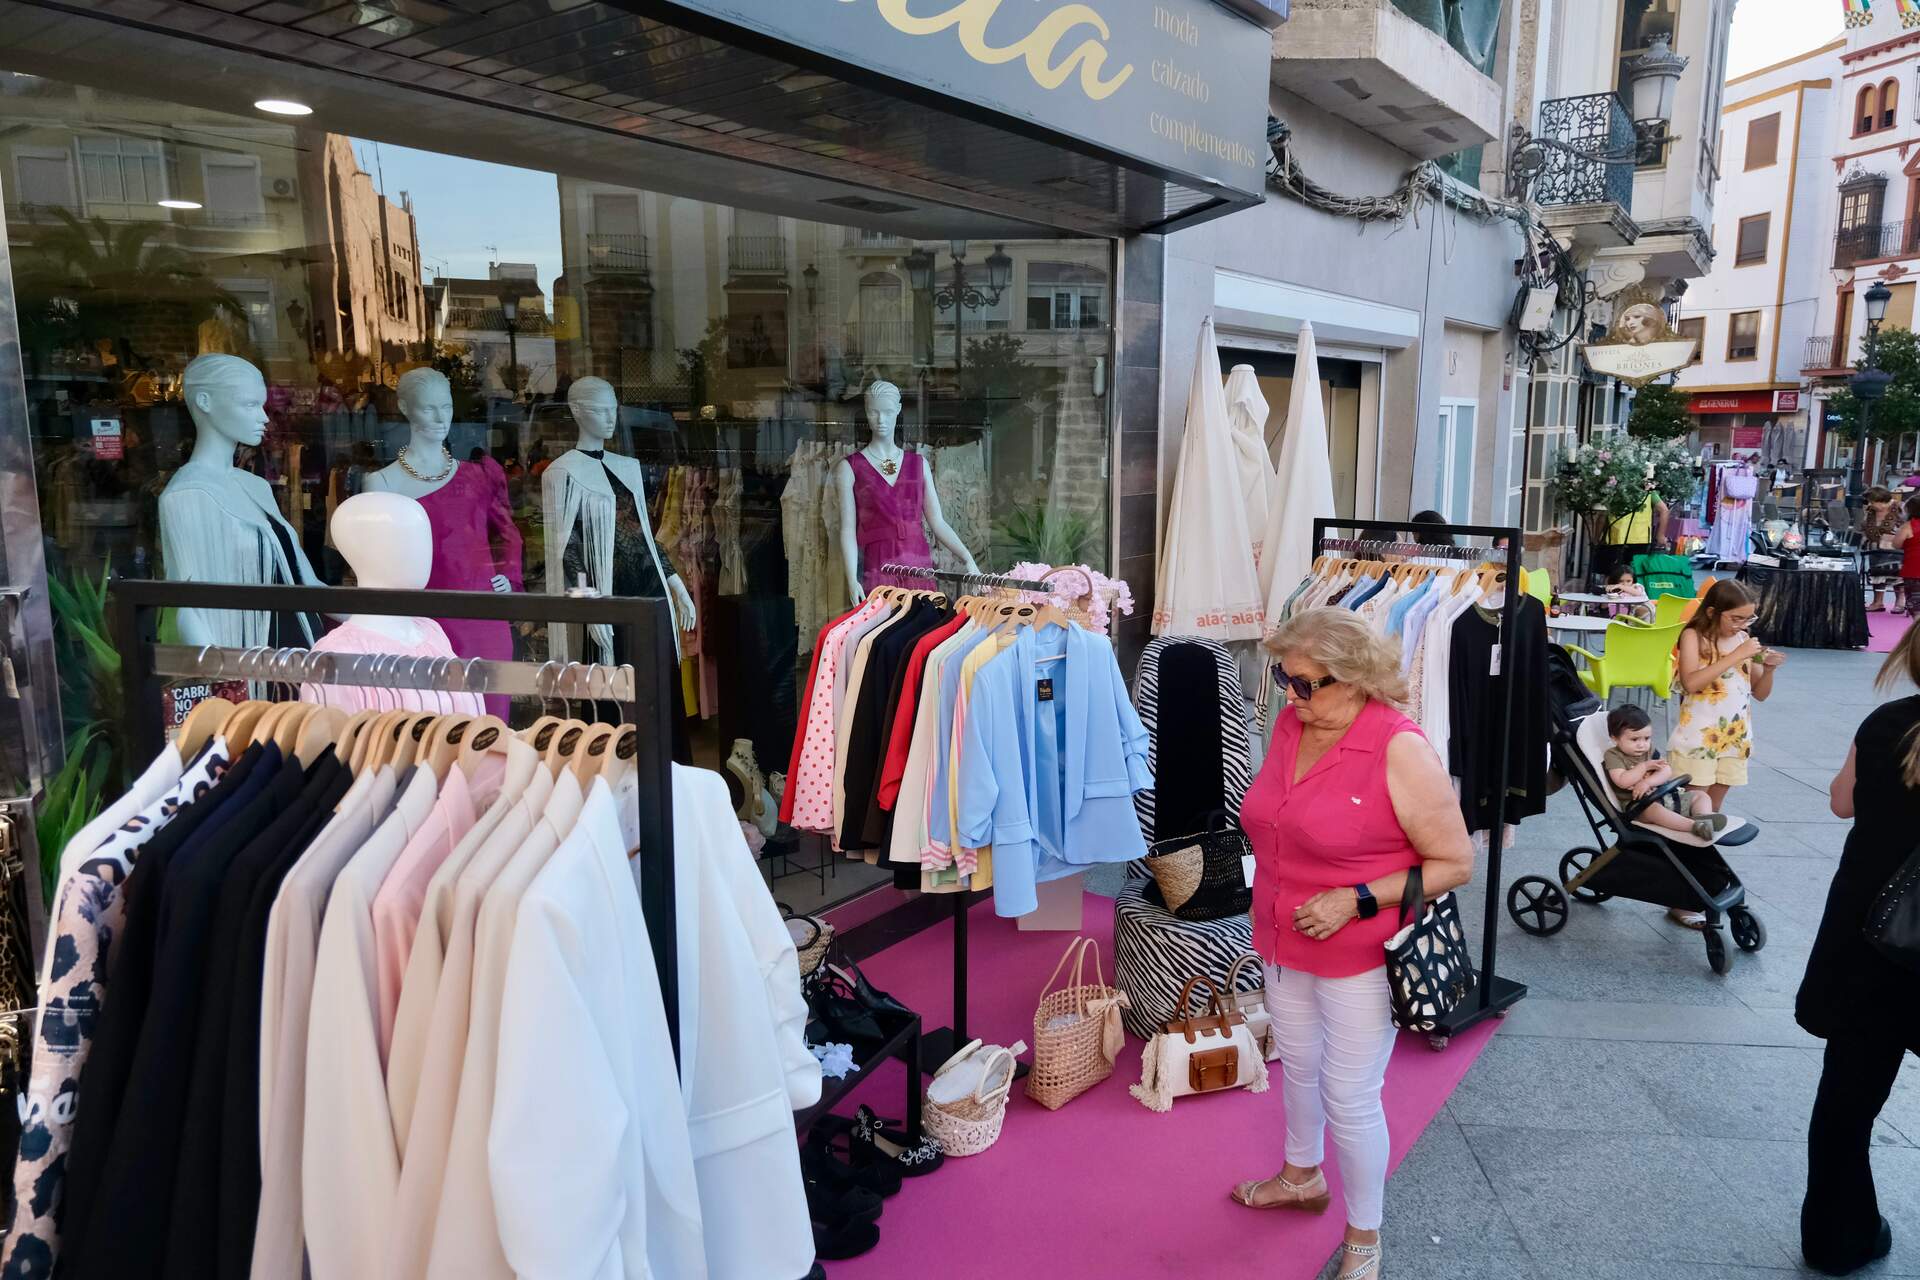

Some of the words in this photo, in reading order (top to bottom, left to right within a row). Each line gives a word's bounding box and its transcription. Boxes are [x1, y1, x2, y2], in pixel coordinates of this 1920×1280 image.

[1153, 6, 1198, 47] moda
[1151, 57, 1209, 104] calzado
[1150, 111, 1255, 168] complementos
[1616, 361, 1664, 370] BRIONES
[174, 698, 193, 713] NO
